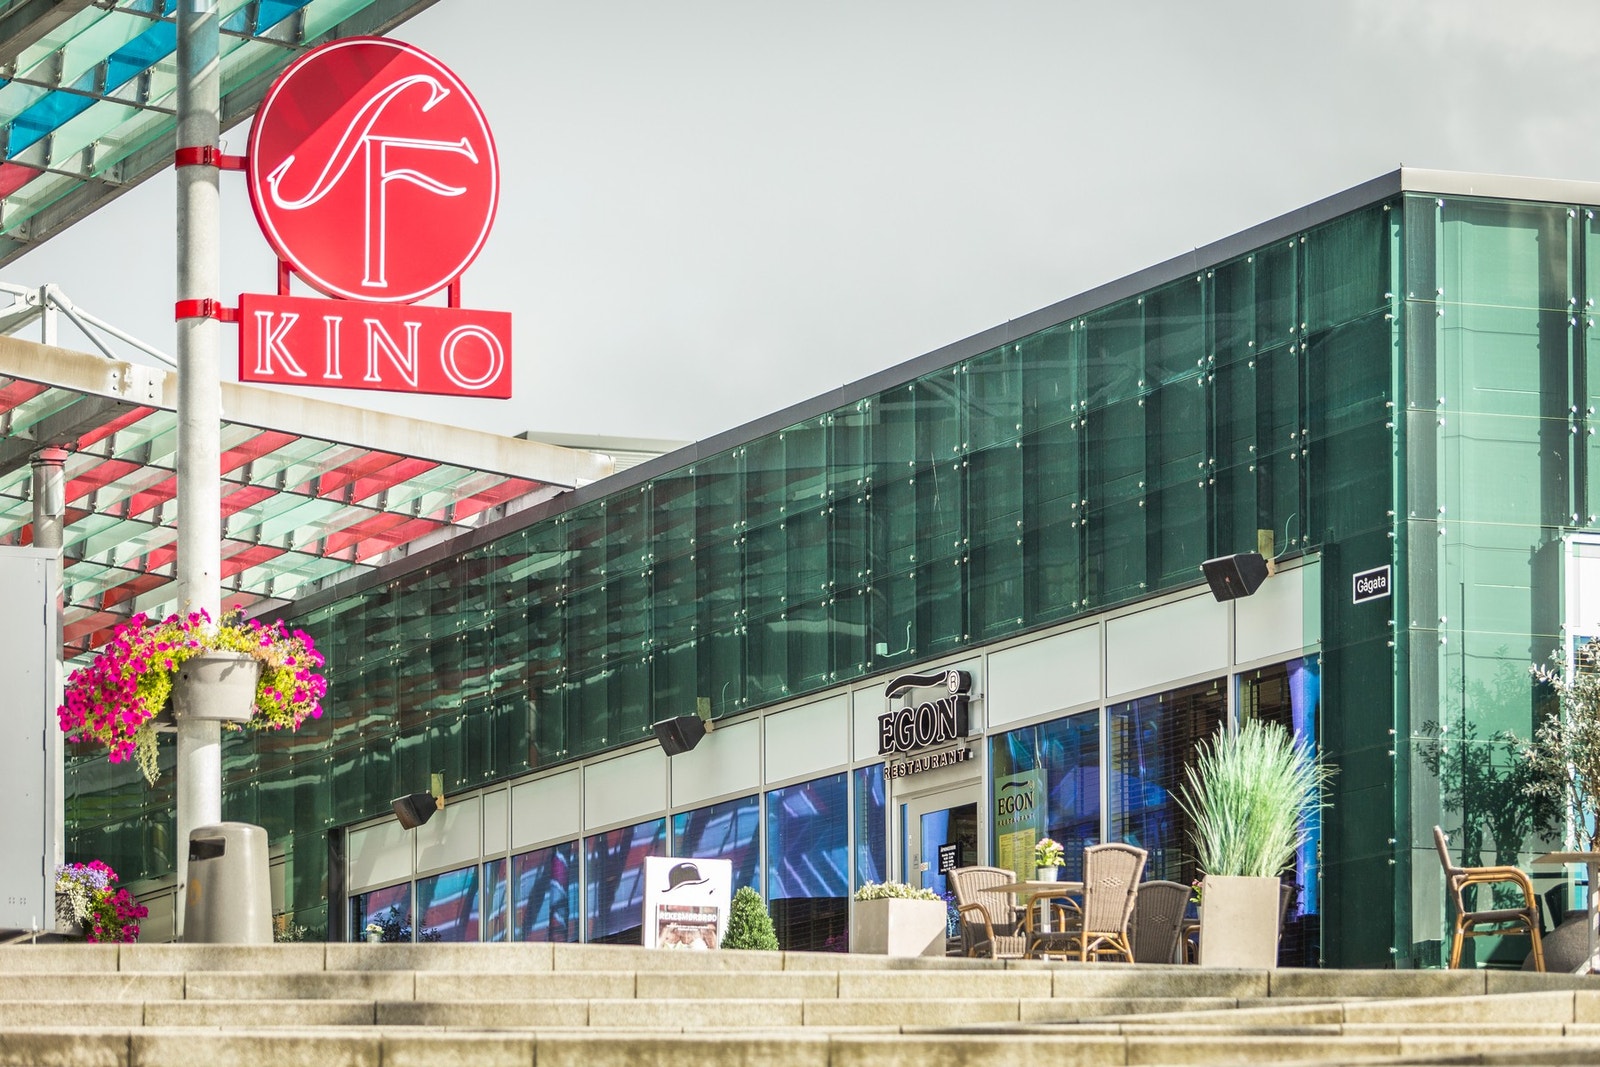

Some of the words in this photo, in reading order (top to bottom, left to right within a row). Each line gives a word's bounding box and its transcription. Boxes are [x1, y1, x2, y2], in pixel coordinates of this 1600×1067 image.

[254, 311, 504, 389] KINO
[1357, 576, 1386, 593] Gågata
[878, 694, 960, 756] EGON
[883, 748, 966, 780] RESTAURANT
[998, 791, 1035, 816] EGON
